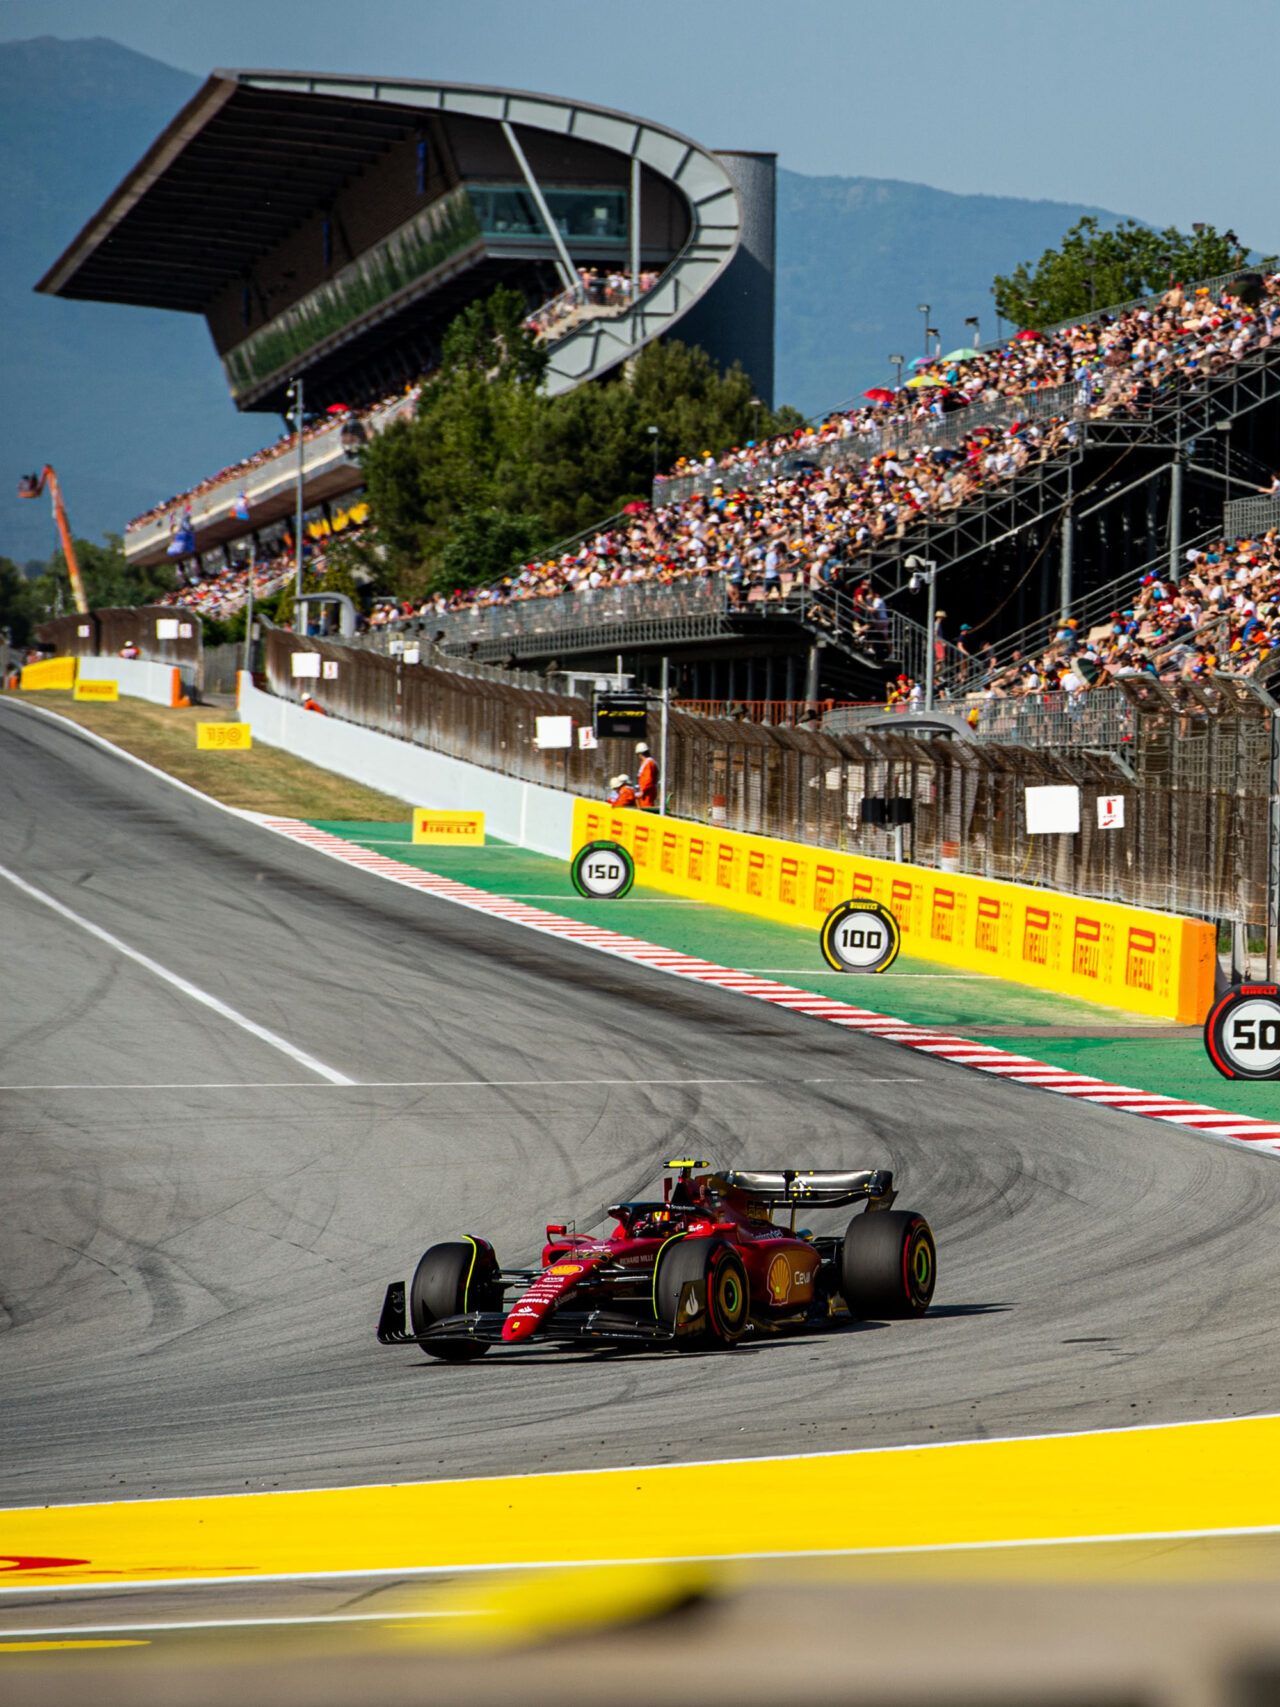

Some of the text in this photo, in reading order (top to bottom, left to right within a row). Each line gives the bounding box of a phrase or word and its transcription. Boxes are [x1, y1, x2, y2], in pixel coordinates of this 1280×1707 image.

[421, 820, 477, 834] PIRELLI
[588, 864, 620, 880] 150
[842, 929, 883, 950] 100
[1124, 927, 1157, 992] PIRELLI
